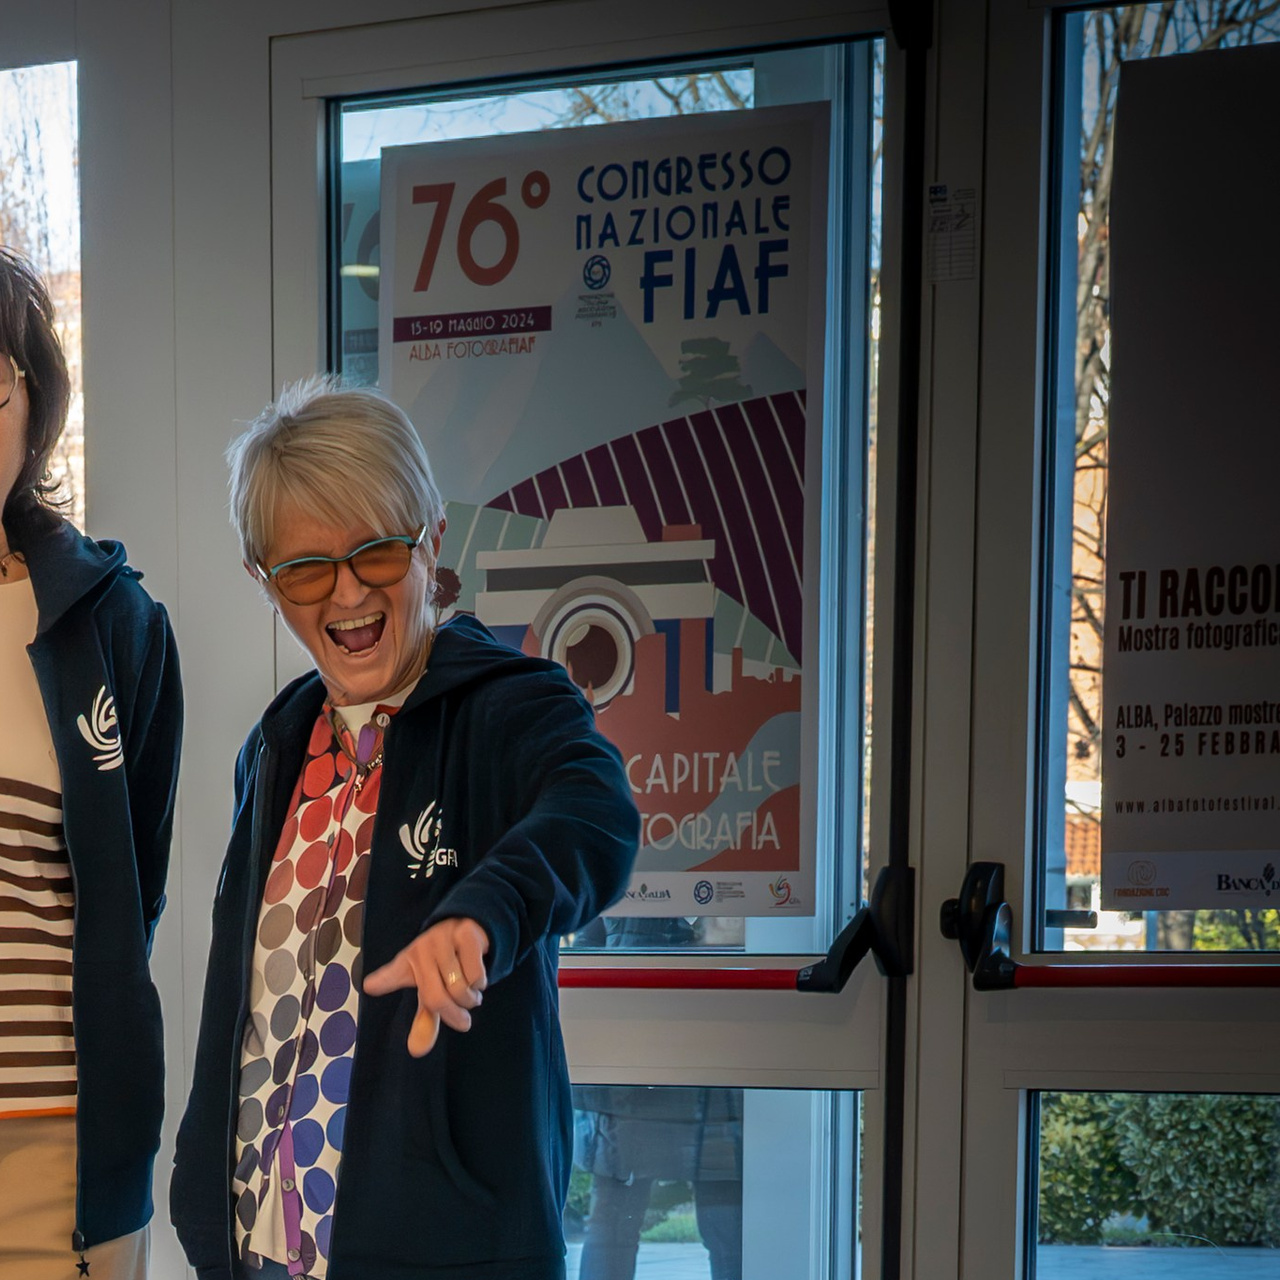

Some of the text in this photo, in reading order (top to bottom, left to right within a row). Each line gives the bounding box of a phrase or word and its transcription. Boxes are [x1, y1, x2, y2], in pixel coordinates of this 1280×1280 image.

[577, 146, 791, 203] CONGRESSO
[575, 195, 790, 250] NAZIONALE
[639, 238, 789, 323] FIAF
[411, 312, 535, 336] 15-19 MAGGIO 2024
[1119, 563, 1280, 620] TI RACCO
[1118, 618, 1280, 652] Mostra fotografic
[1116, 704, 1159, 732] ALBA,
[1164, 702, 1223, 728] Palazzo
[1116, 734, 1126, 759] 3
[1160, 732, 1185, 758] 25
[624, 750, 783, 794] CAPITALE
